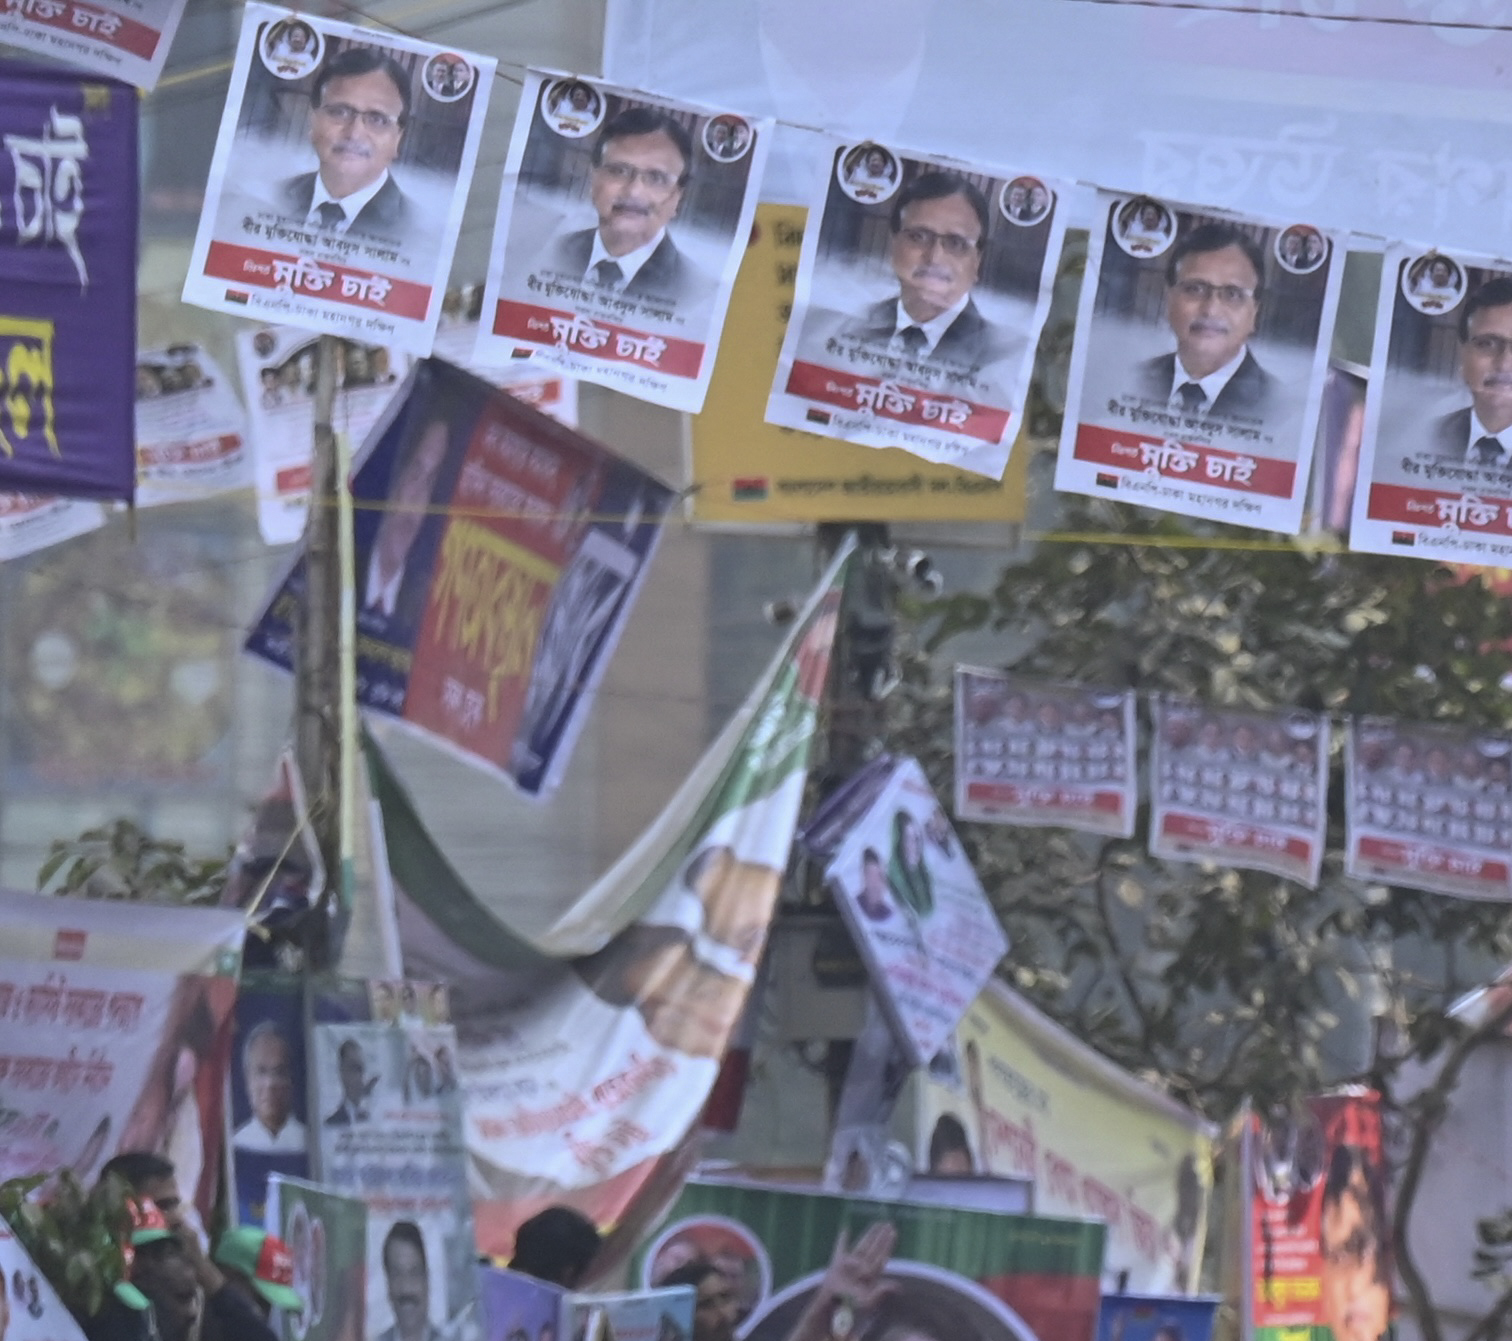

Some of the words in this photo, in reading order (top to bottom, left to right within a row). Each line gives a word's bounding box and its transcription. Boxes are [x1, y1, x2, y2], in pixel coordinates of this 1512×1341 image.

[274, 255, 333, 297] মুক্তি
[338, 270, 392, 306] চাই
[552, 312, 608, 356] মুক্তি
[615, 328, 665, 365] চাই
[856, 377, 914, 418] মুক্তি
[918, 394, 971, 430] চাই
[1139, 435, 1198, 480] মুক্তি
[1204, 449, 1255, 485] চাই
[1436, 490, 1497, 536] মুক্তি
